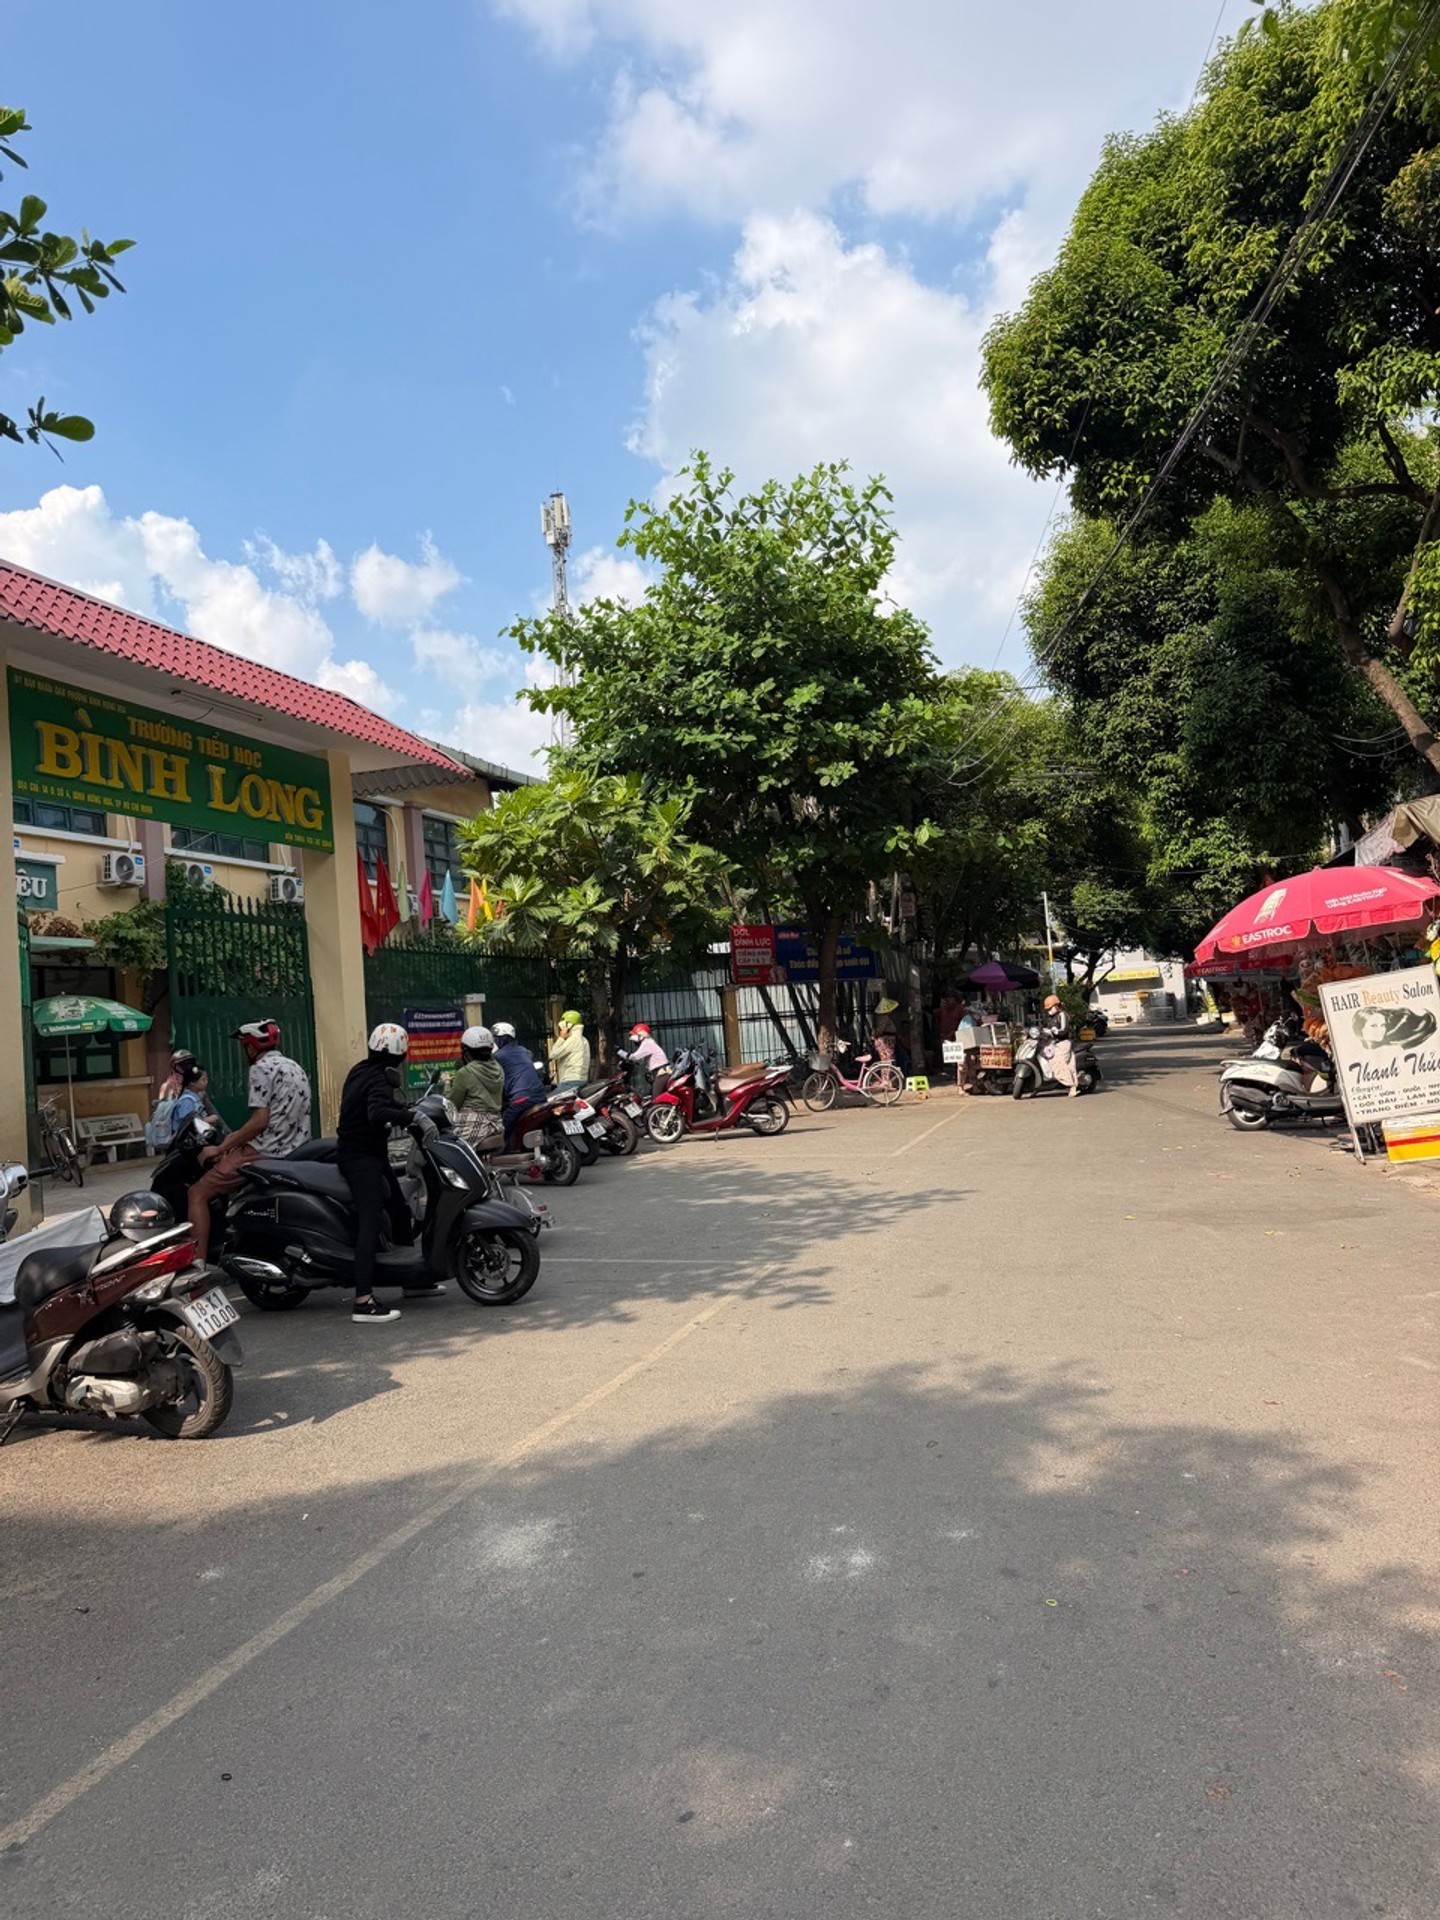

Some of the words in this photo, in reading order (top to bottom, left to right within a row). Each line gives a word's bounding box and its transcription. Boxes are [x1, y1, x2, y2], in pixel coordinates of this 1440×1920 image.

[127, 716, 193, 750] TRƯỜNG
[197, 732, 229, 760] TIỂU
[233, 745, 262, 770] HỌC
[34, 707, 191, 804] BÌNH
[206, 764, 325, 831] LONG
[734, 936, 754, 946] ĐÌNH
[754, 937, 771, 947] LỰC
[1241, 924, 1292, 945] EASTROC
[1330, 993, 1361, 1012] HAIR
[1362, 988, 1400, 1006] Beauty
[1402, 981, 1434, 1000] Salon
[1348, 1057, 1399, 1084] Thanh
[1360, 1105, 1391, 1114] TRANG
[191, 1292, 223, 1318] 18-K1
[197, 1305, 236, 1336] 110.00
